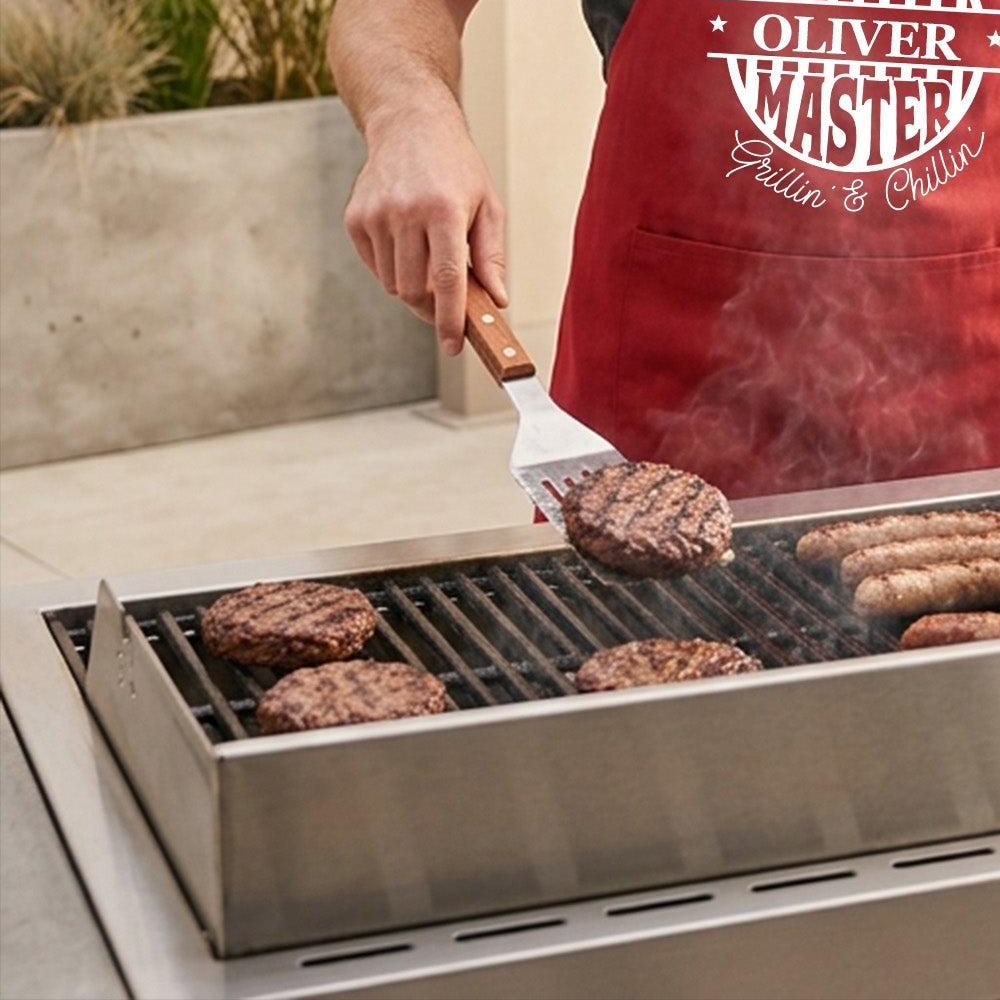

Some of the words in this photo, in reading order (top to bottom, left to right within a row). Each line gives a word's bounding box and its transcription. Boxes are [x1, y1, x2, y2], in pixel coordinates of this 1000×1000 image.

[753, 14, 961, 61] OLIVER
[755, 73, 951, 168] MASTER
[843, 179, 868, 212] &
